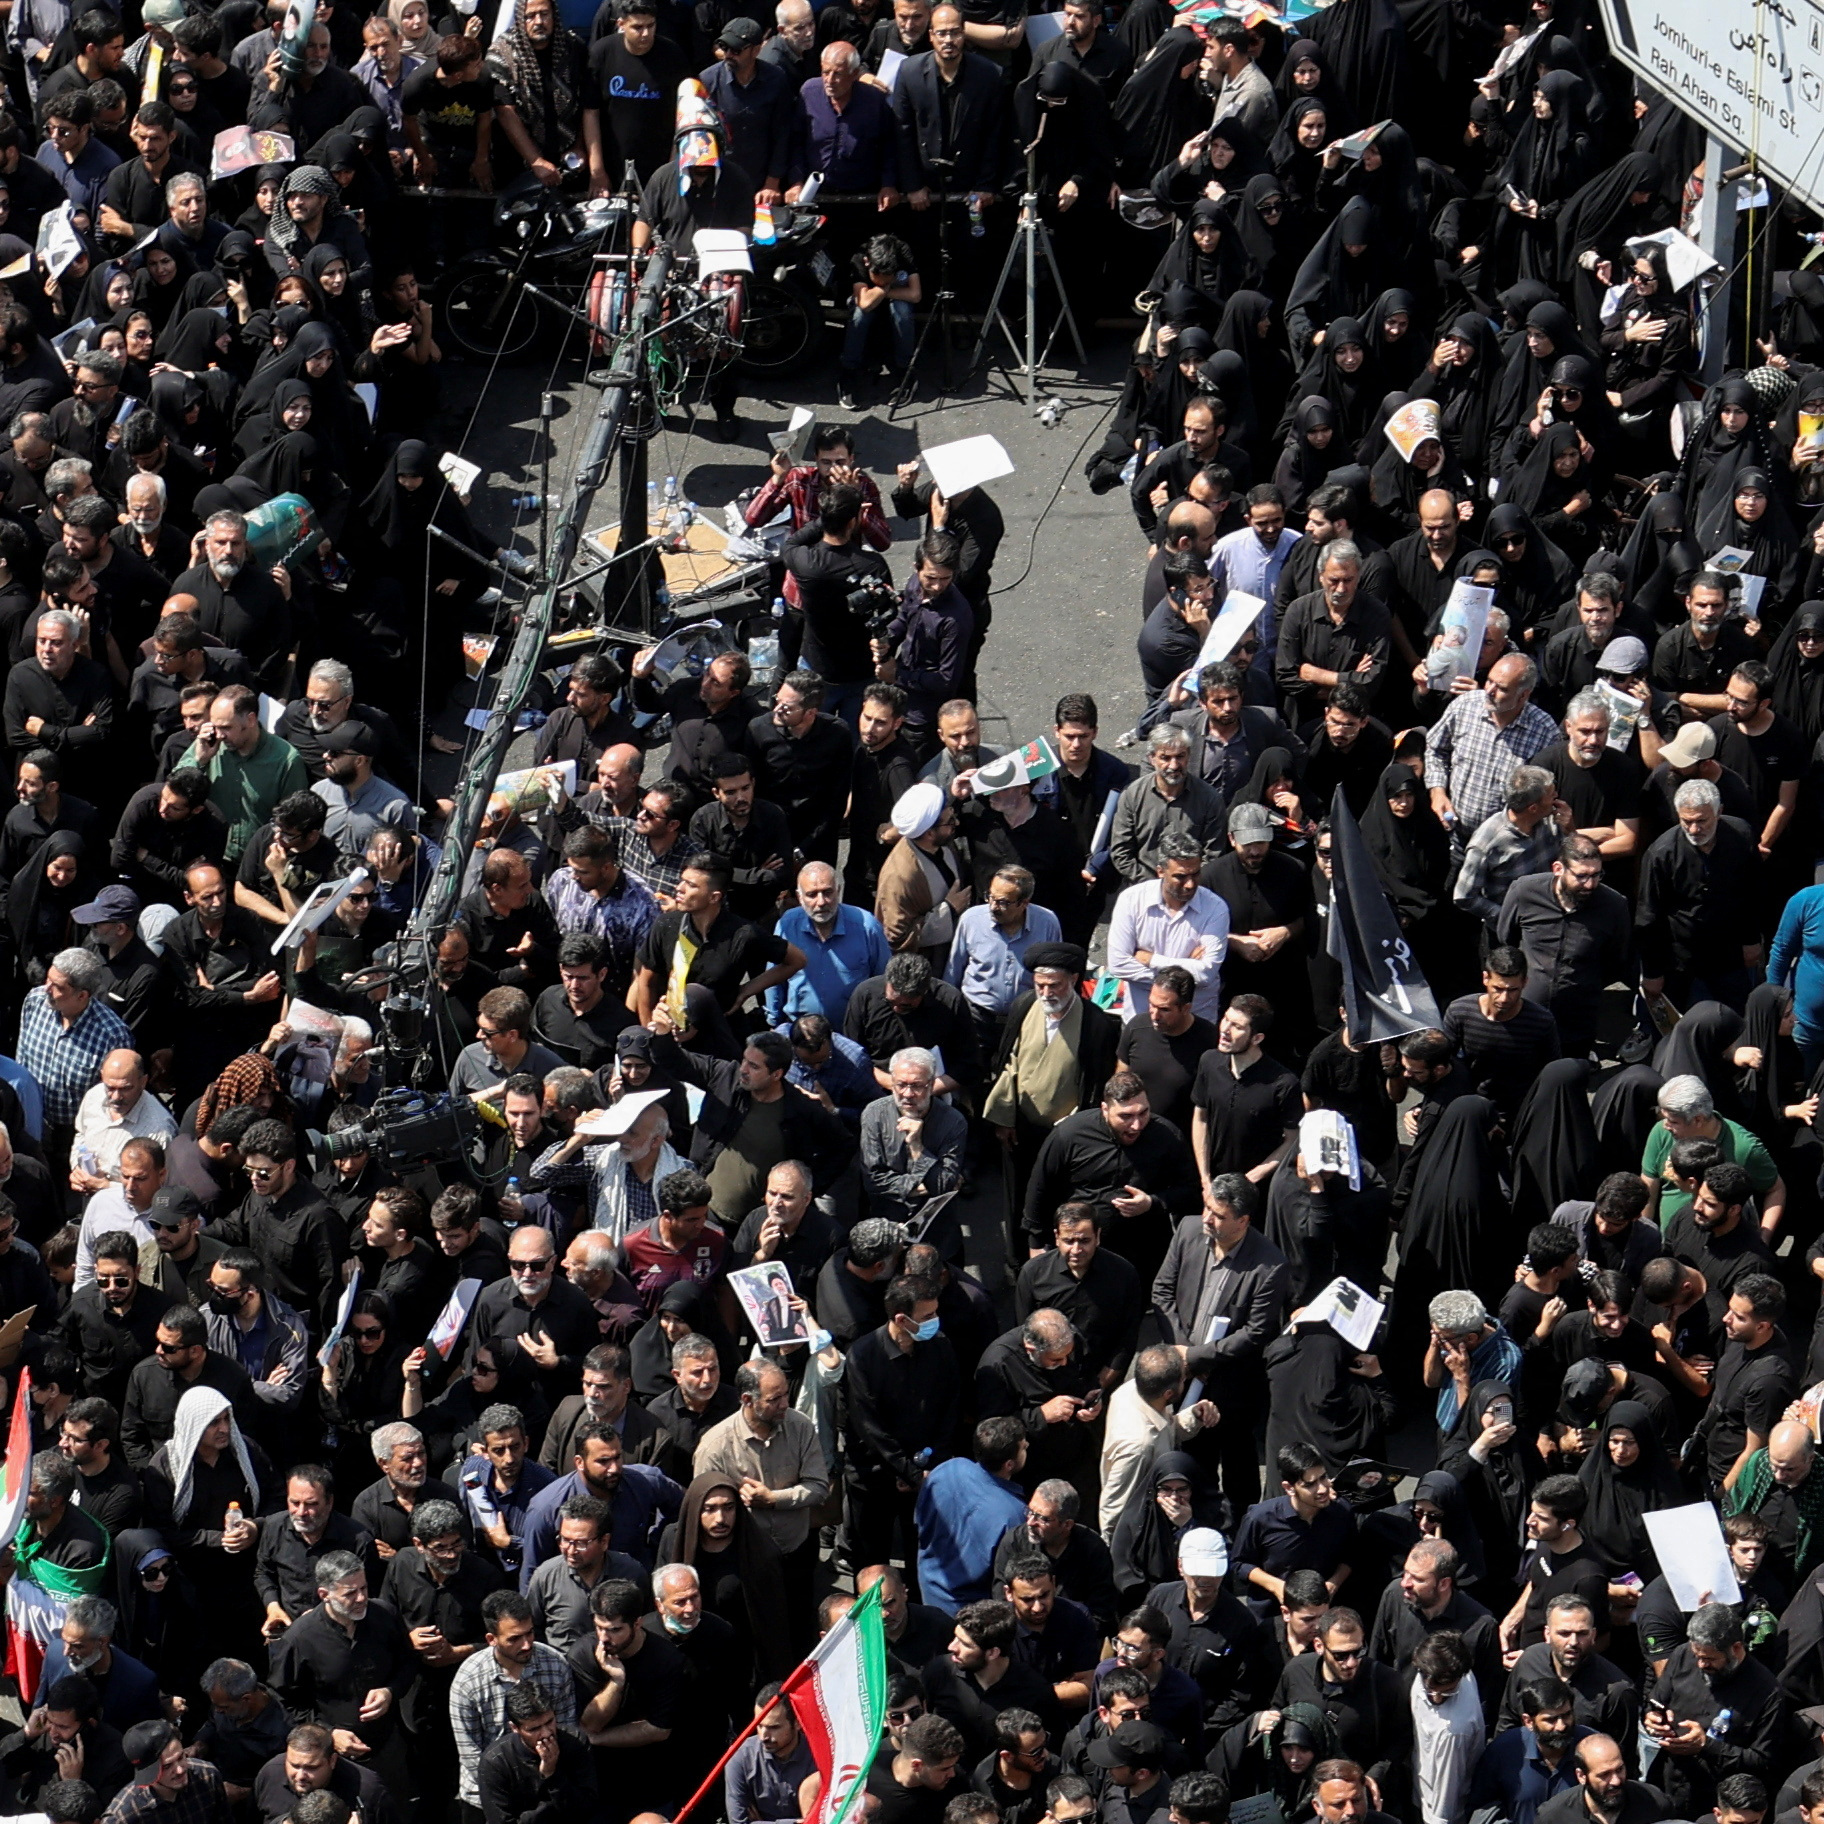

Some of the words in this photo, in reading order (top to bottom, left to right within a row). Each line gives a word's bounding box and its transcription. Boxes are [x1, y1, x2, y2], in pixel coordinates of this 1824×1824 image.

[1650, 46, 1678, 83] Rah
[1681, 76, 1718, 114] Ahan
[1722, 104, 1746, 135] Sq.
[1654, 13, 1722, 78] Jomhuri-e
[1727, 70, 1776, 119] Eslami
[1779, 110, 1801, 138] St.
